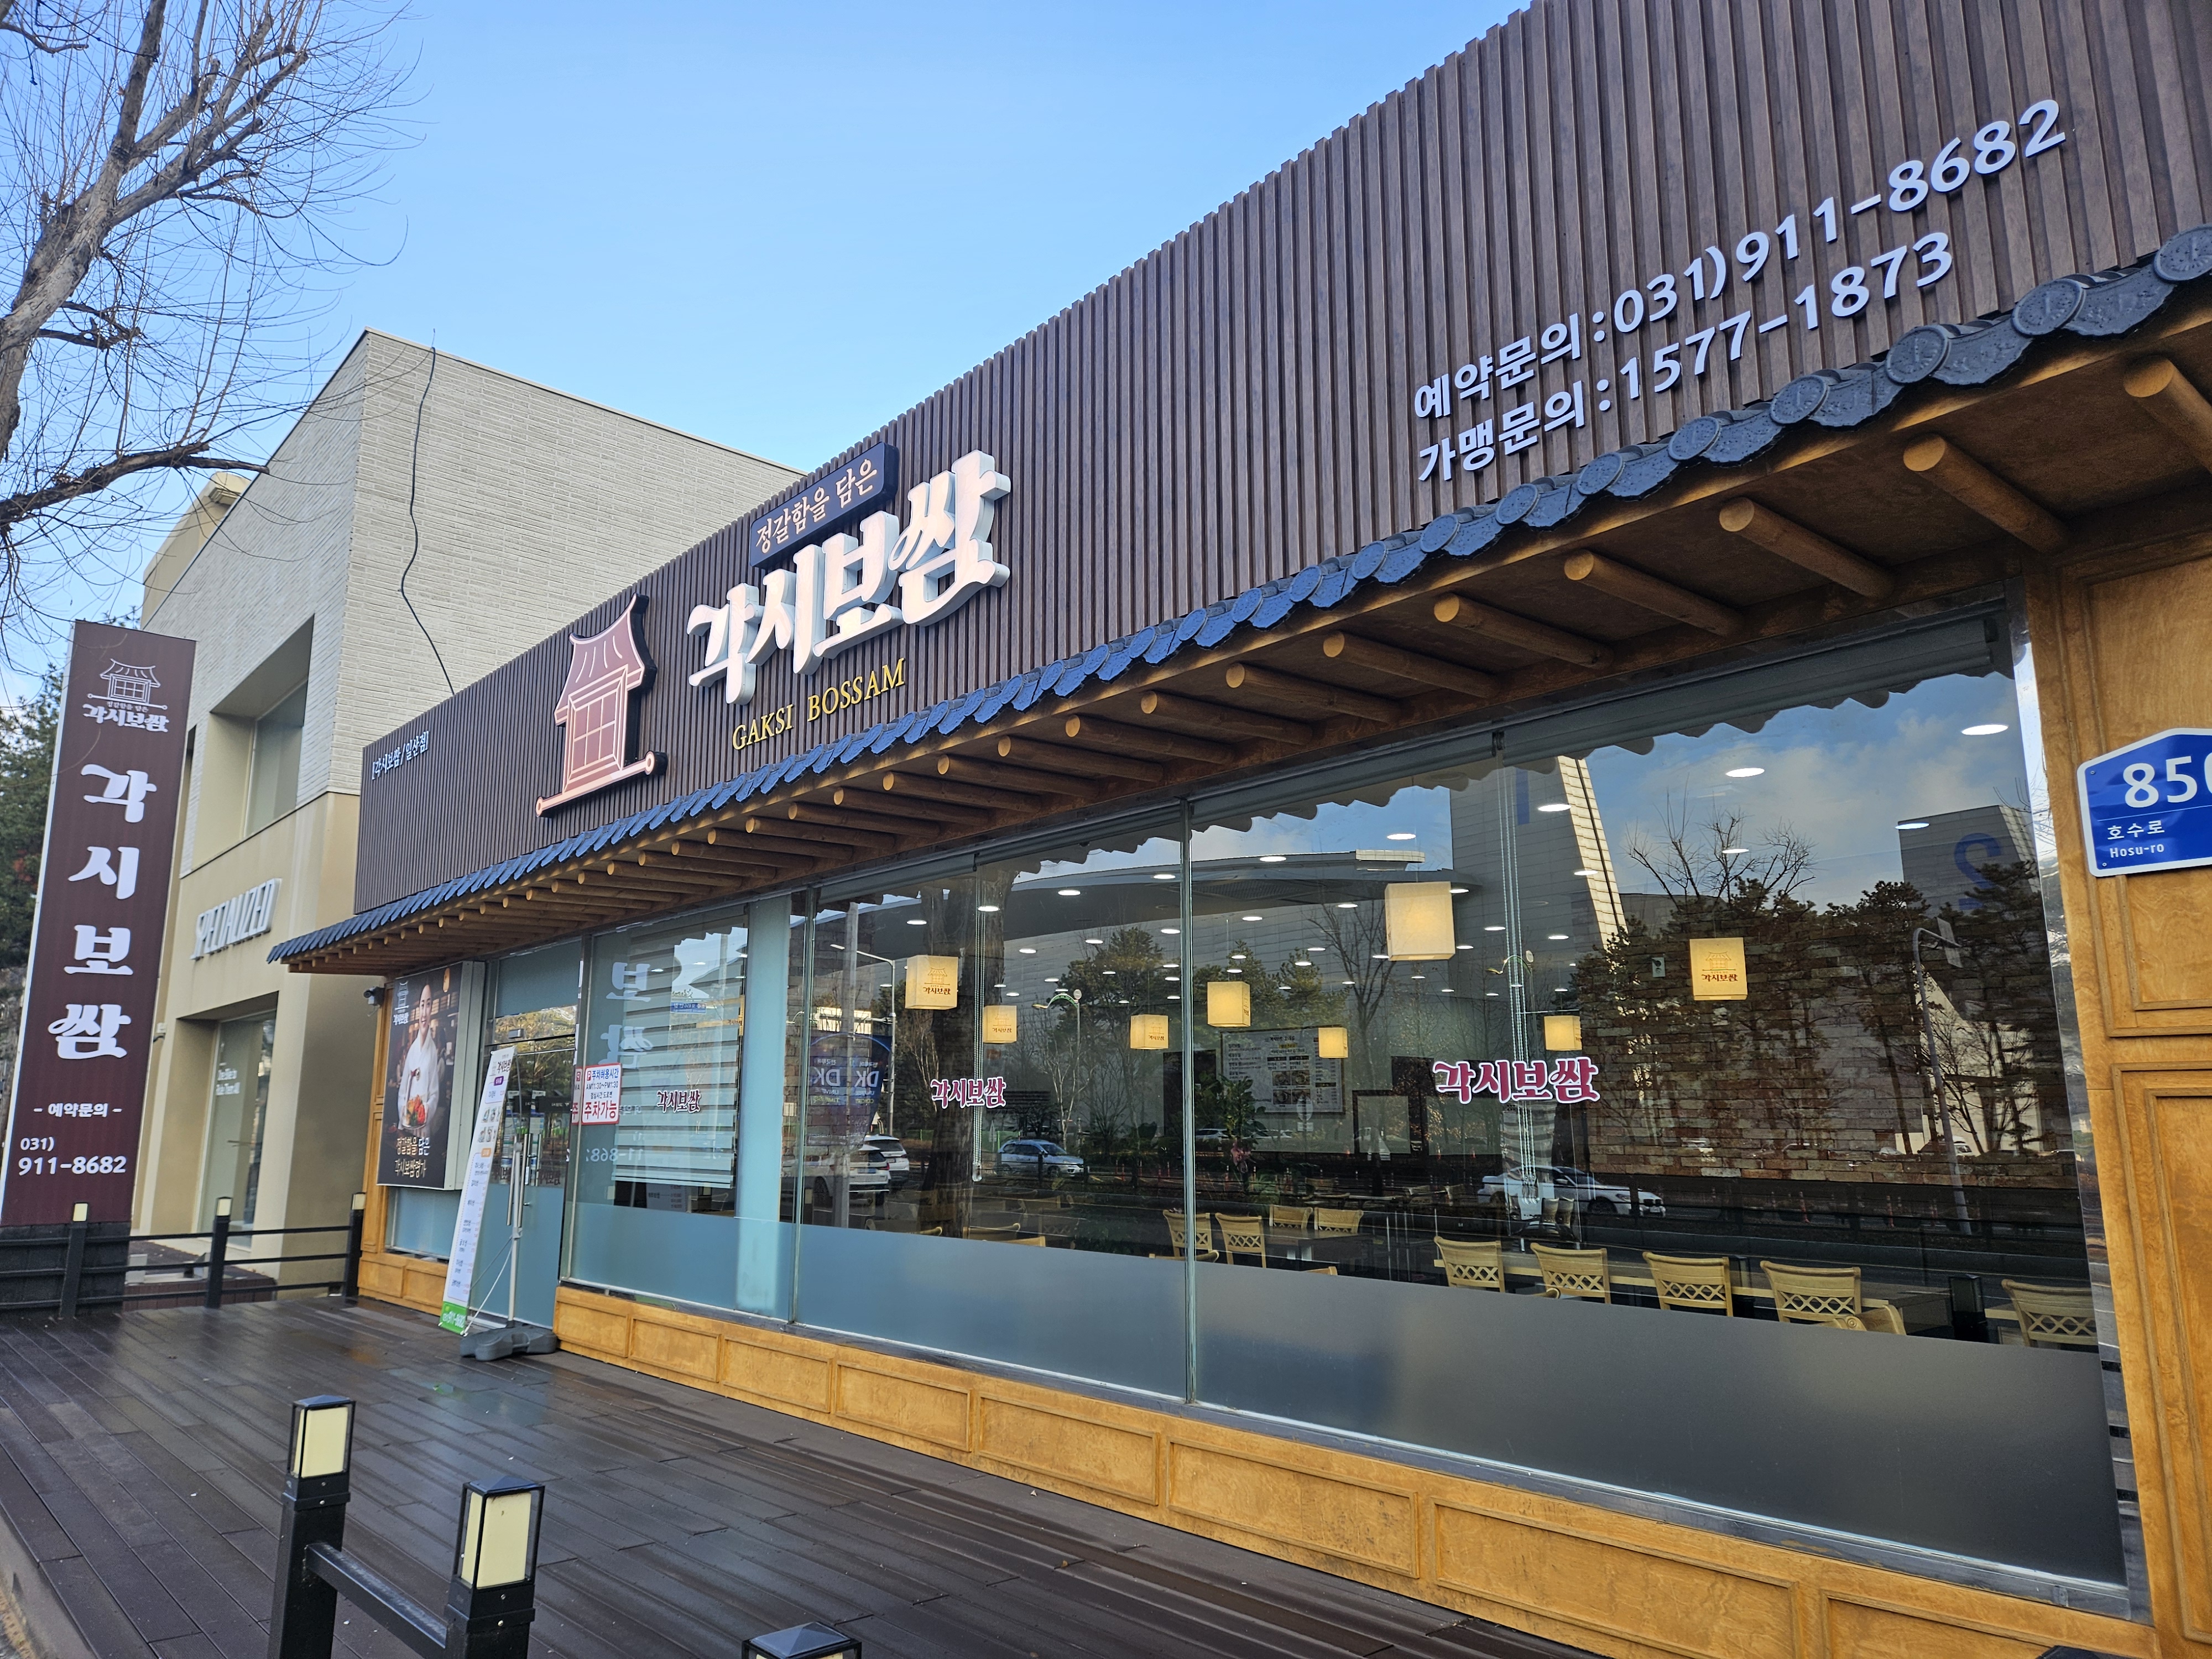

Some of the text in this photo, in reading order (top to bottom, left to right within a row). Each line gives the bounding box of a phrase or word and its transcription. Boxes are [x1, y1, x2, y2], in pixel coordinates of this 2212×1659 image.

[755, 458, 878, 555] 정갈함을 담은
[687, 449, 1011, 705] 각시보쌈
[732, 658, 906, 750] GAKSI BOSSAM
[82, 703, 170, 733] 각시보쌈
[2122, 752, 2212, 808] 85
[2107, 820, 2165, 840] 호수로
[2109, 843, 2165, 858] Hosu-ro
[1701, 973, 1739, 982] 각시보쌈
[922, 987, 951, 995] 각시보쌈
[592, 1068, 619, 1081] 주차허용시간
[1433, 1056, 1600, 1104] 각시보쌈
[656, 1089, 701, 1113] 각시보쌈
[930, 1076, 1007, 1109] 각시보쌈
[48, 1103, 108, 1118] 예약문의
[585, 1100, 617, 1120] 주차가능
[20, 1138, 55, 1151] 031)
[397, 1136, 431, 1156] 정갈함을 담은
[18, 1155, 127, 1176] 911-8682
